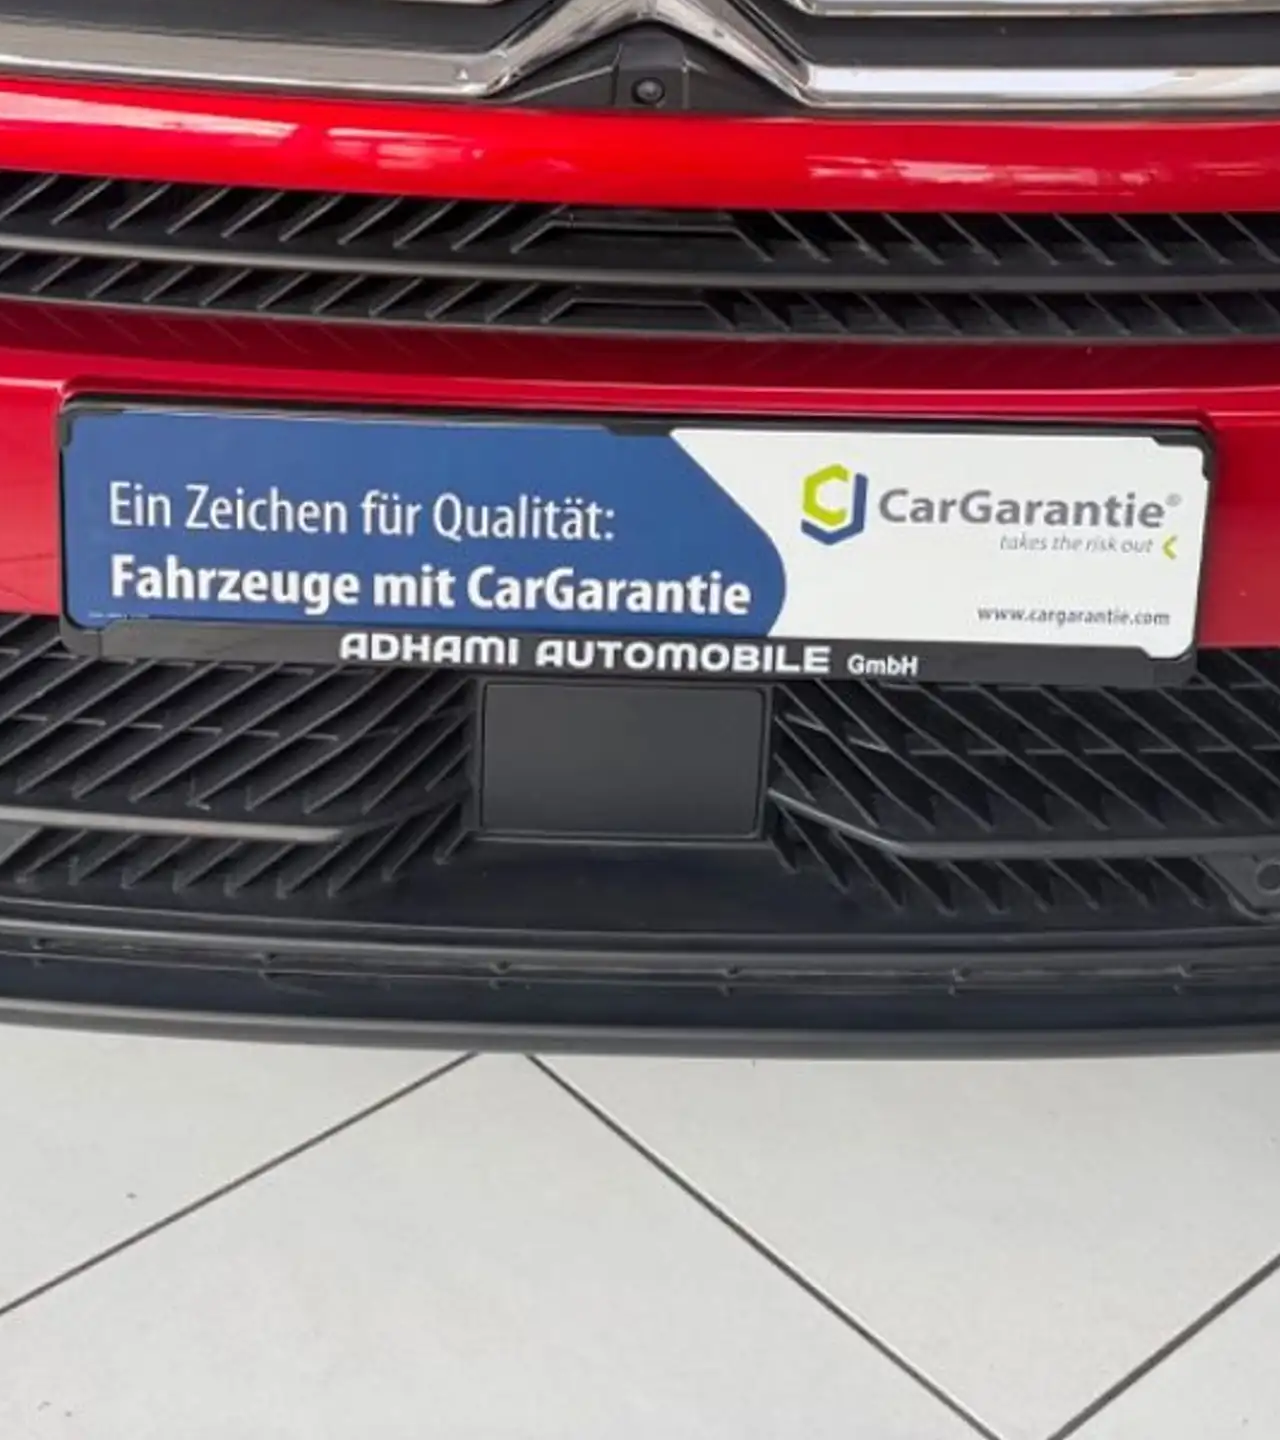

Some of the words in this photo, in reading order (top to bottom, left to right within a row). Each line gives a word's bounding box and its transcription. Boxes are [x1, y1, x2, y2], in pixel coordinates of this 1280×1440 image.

[109, 480, 170, 528] Ein
[184, 482, 348, 534] Zeichen
[360, 488, 422, 537] für
[433, 493, 616, 542] Qualität:
[999, 532, 1049, 553] takes
[1052, 534, 1082, 552] the
[1085, 535, 1118, 553] risk
[1120, 538, 1154, 555] out
[111, 553, 361, 616] Fahrzeuge
[372, 563, 457, 608] mit
[466, 565, 753, 615] CarGarantie
[976, 603, 1172, 628] www.cargarantie.com
[339, 632, 519, 667] ADHAMI
[535, 639, 831, 674] AUTOMOBILE
[847, 652, 919, 677] GmbH
